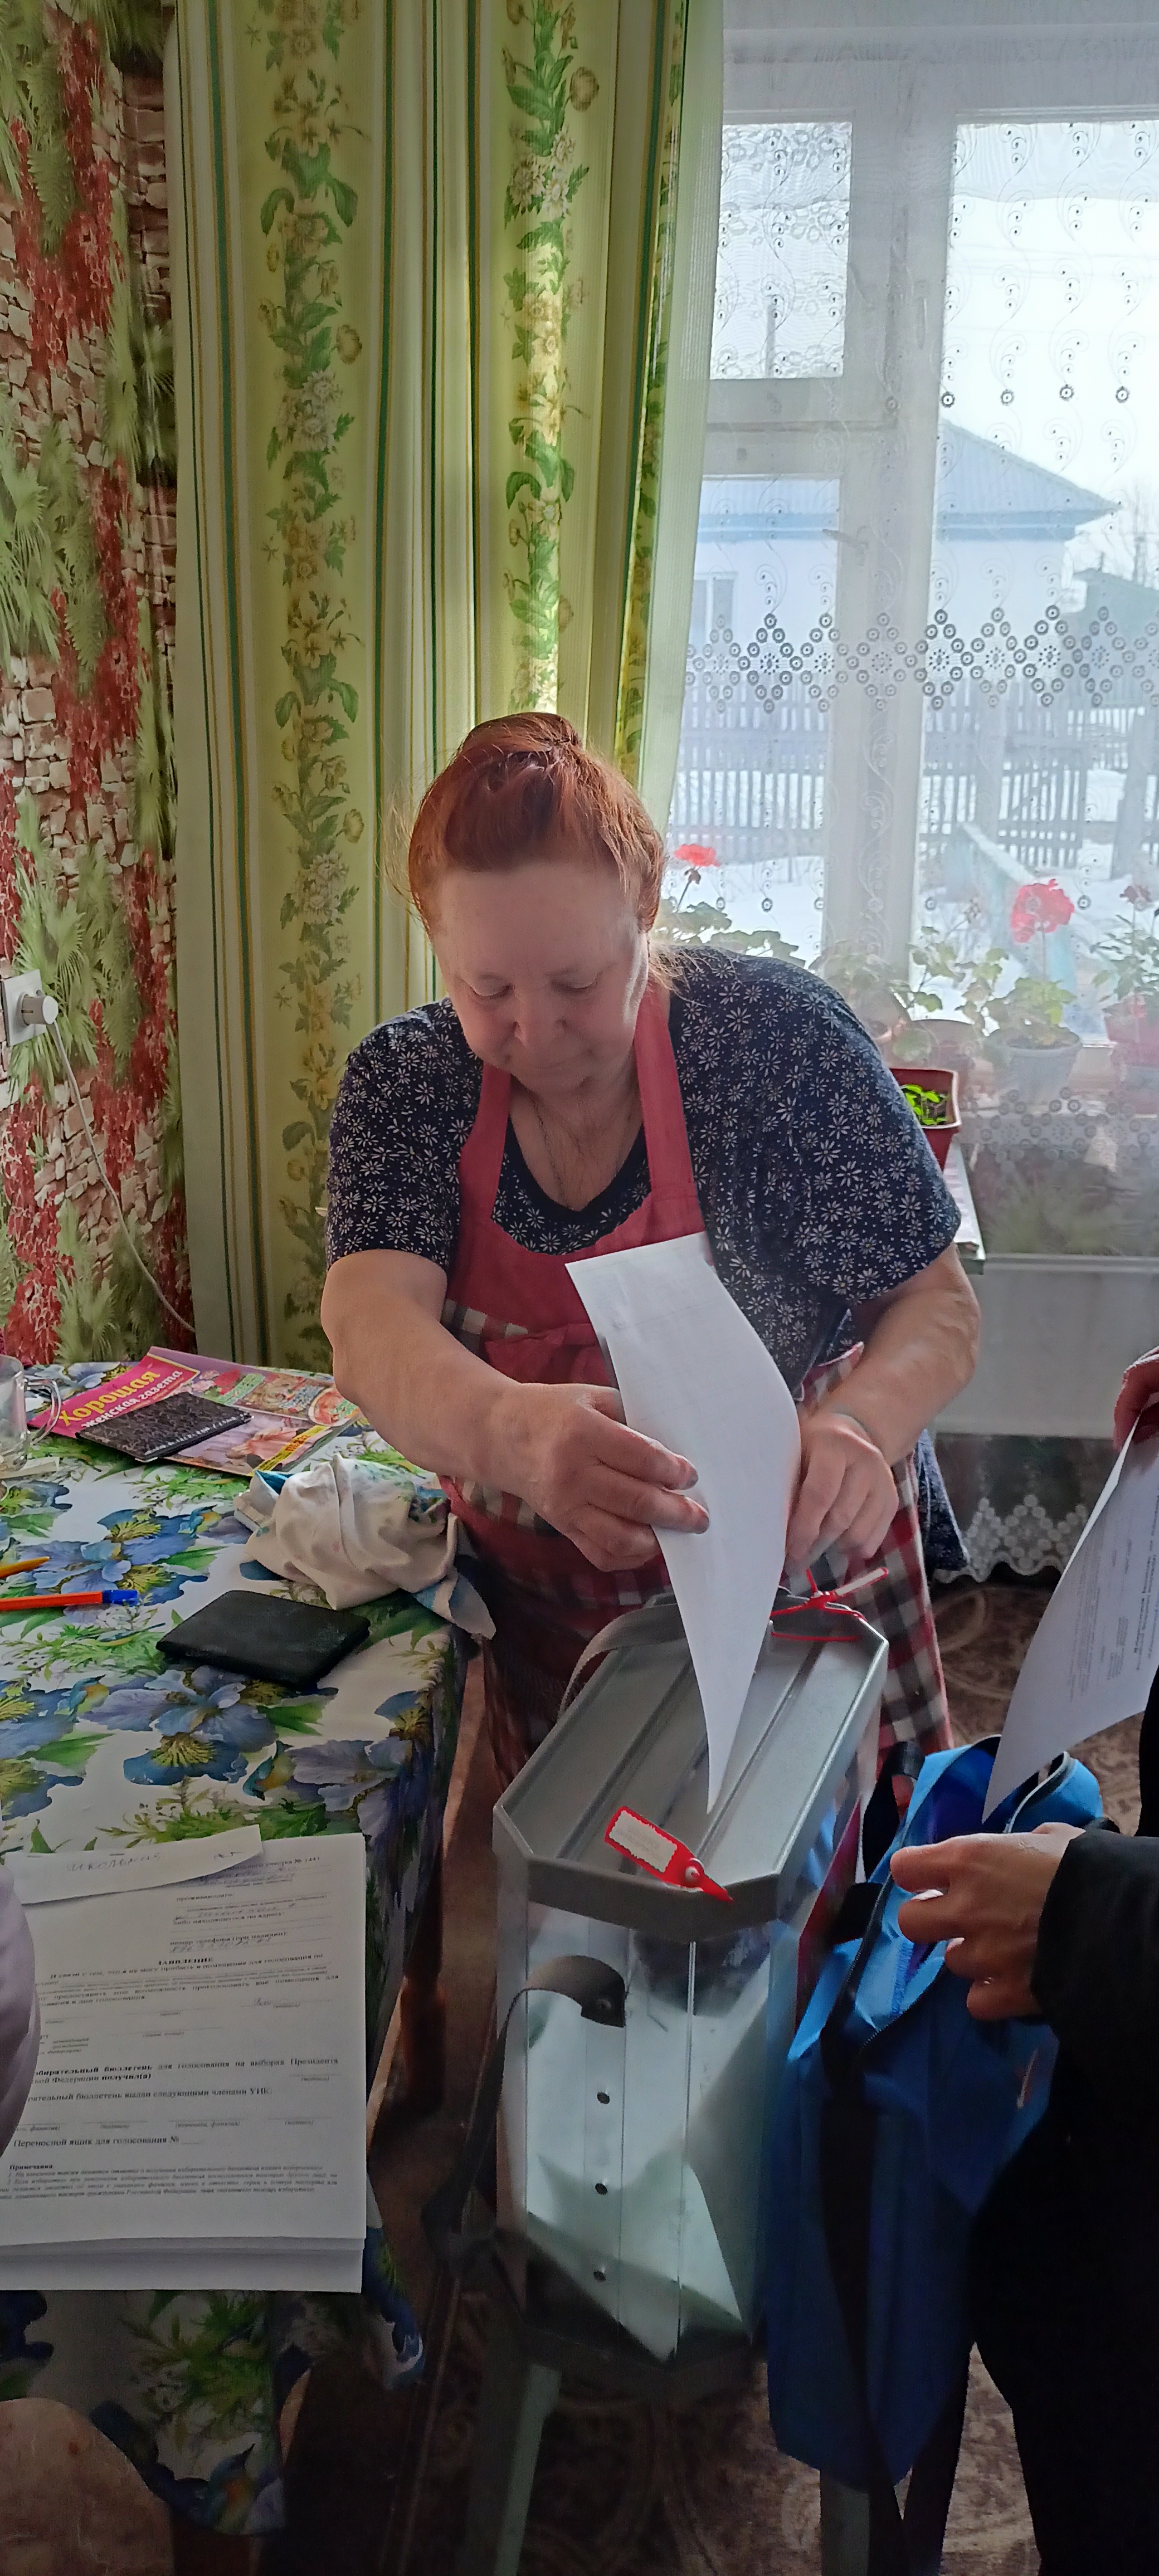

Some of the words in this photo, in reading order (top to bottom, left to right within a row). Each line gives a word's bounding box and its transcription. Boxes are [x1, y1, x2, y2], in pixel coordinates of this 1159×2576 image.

[59, 1371, 160, 1426] Хорошая
[81, 1398, 140, 1428] женская
[138, 1370, 182, 1400] газета
[14, 2139, 67, 2148] Переносной
